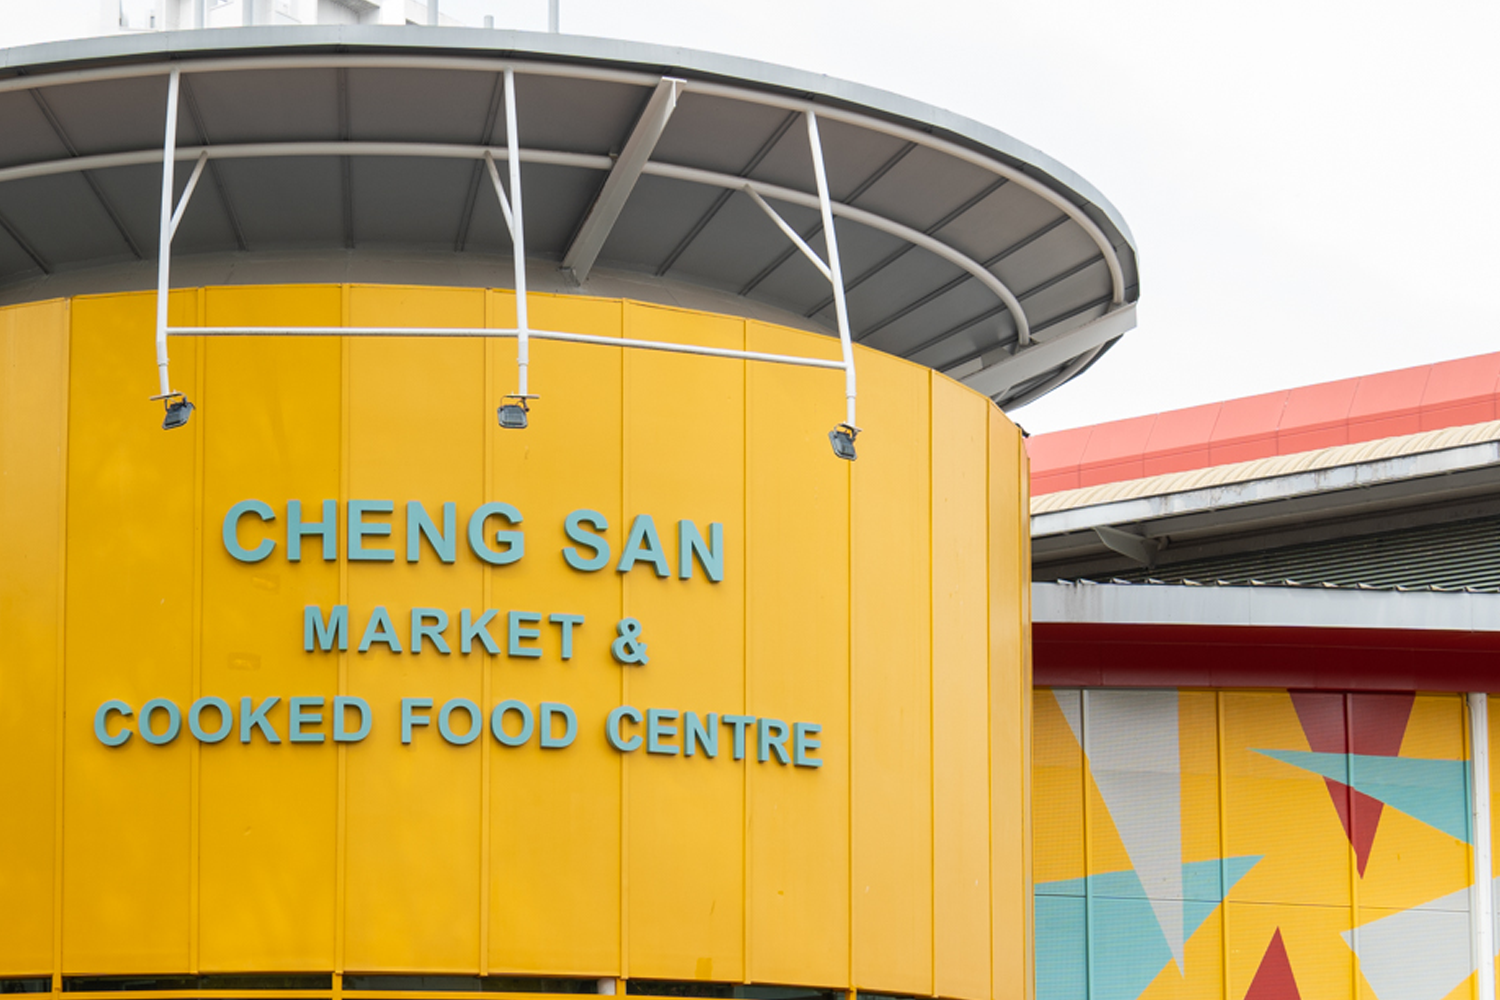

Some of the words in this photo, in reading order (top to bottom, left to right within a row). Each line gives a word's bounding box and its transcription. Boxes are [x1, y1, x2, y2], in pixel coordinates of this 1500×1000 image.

[222, 498, 525, 566] CHENG
[562, 508, 724, 584] SAN
[303, 604, 585, 661] MARKET
[611, 617, 650, 666] &
[94, 696, 373, 747] COOKED
[401, 697, 578, 749] FOOD
[605, 705, 824, 769] CENTRE
